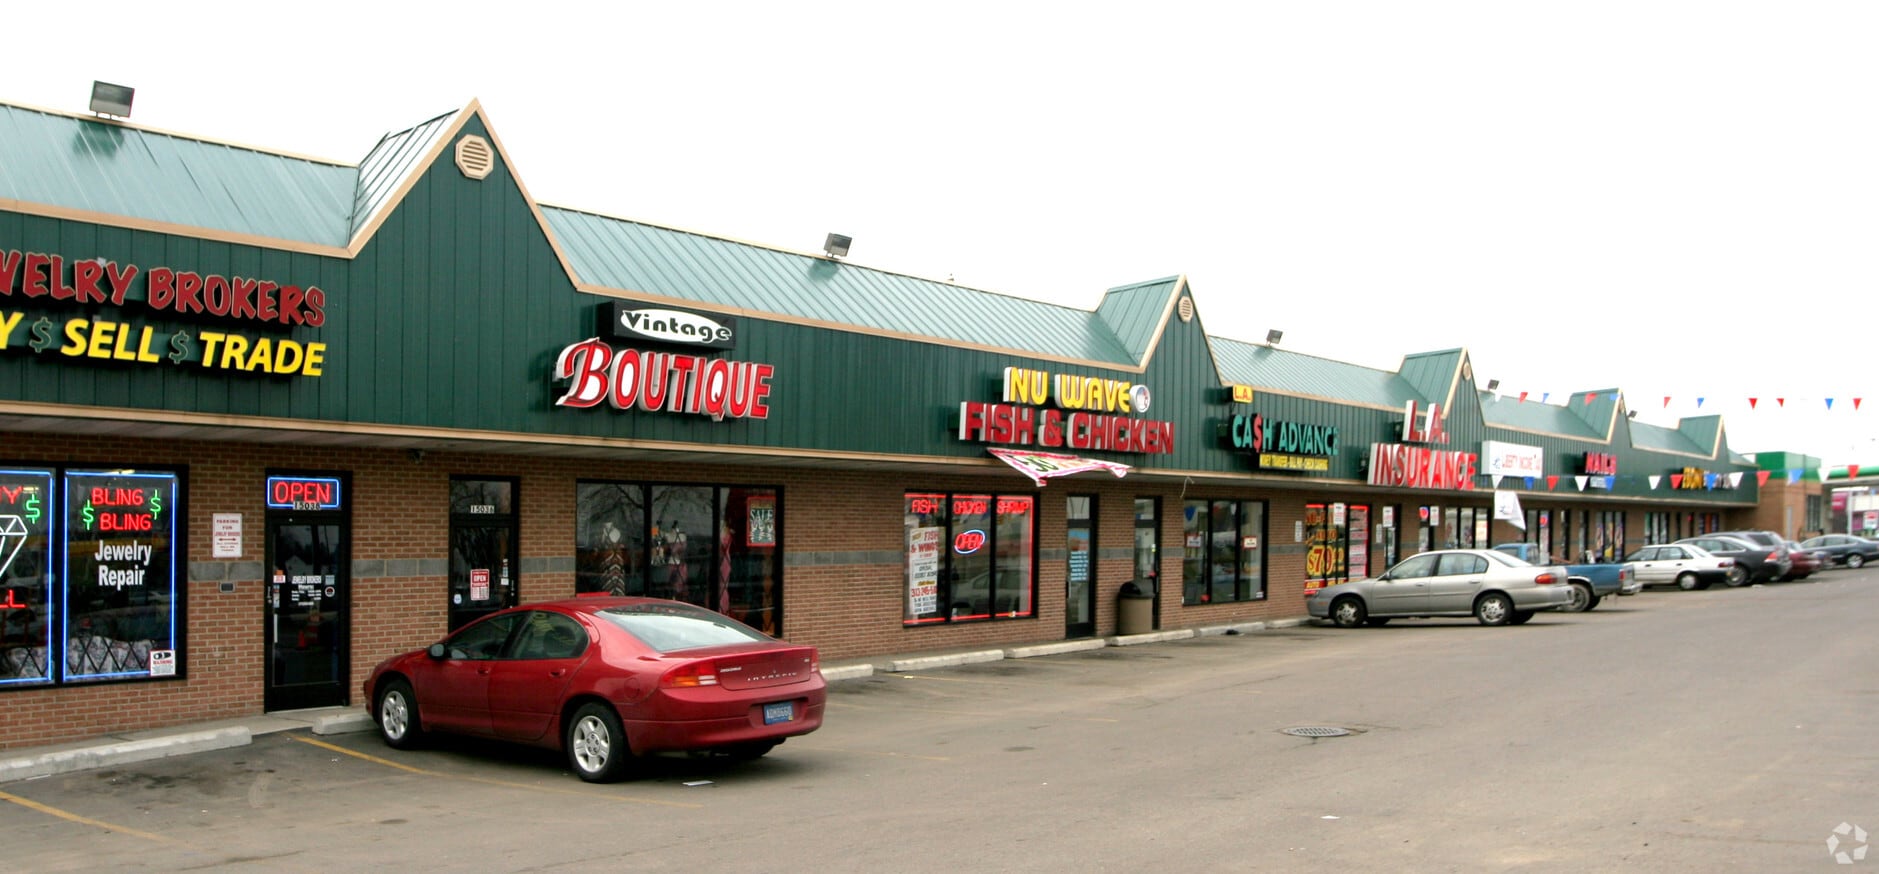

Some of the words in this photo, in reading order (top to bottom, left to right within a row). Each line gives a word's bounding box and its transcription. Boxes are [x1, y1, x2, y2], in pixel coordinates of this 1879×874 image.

[149, 267, 326, 327] BROKERS
[622, 309, 733, 344] Vintage
[61, 318, 160, 363] SELL
[200, 331, 327, 376] TRADE
[555, 337, 774, 421] BOUTIQUE
[1003, 367, 1048, 405] NU
[1054, 374, 1132, 413] WAVE
[959, 401, 1035, 444] FISH
[1038, 409, 1064, 446] &
[1067, 411, 1175, 454] CHICKEN
[1278, 421, 1339, 455] ADVANCE
[1402, 400, 1449, 444] L.A.
[1367, 443, 1478, 490] INSURANCE
[1585, 452, 1617, 475] NAILS
[92, 488, 144, 506] BLING
[274, 481, 331, 503] OPEN
[911, 499, 939, 513] FISH
[100, 514, 152, 531] BLING
[95, 540, 152, 565] Jewelry
[955, 533, 985, 550] OPEN
[99, 565, 145, 591] Repair
